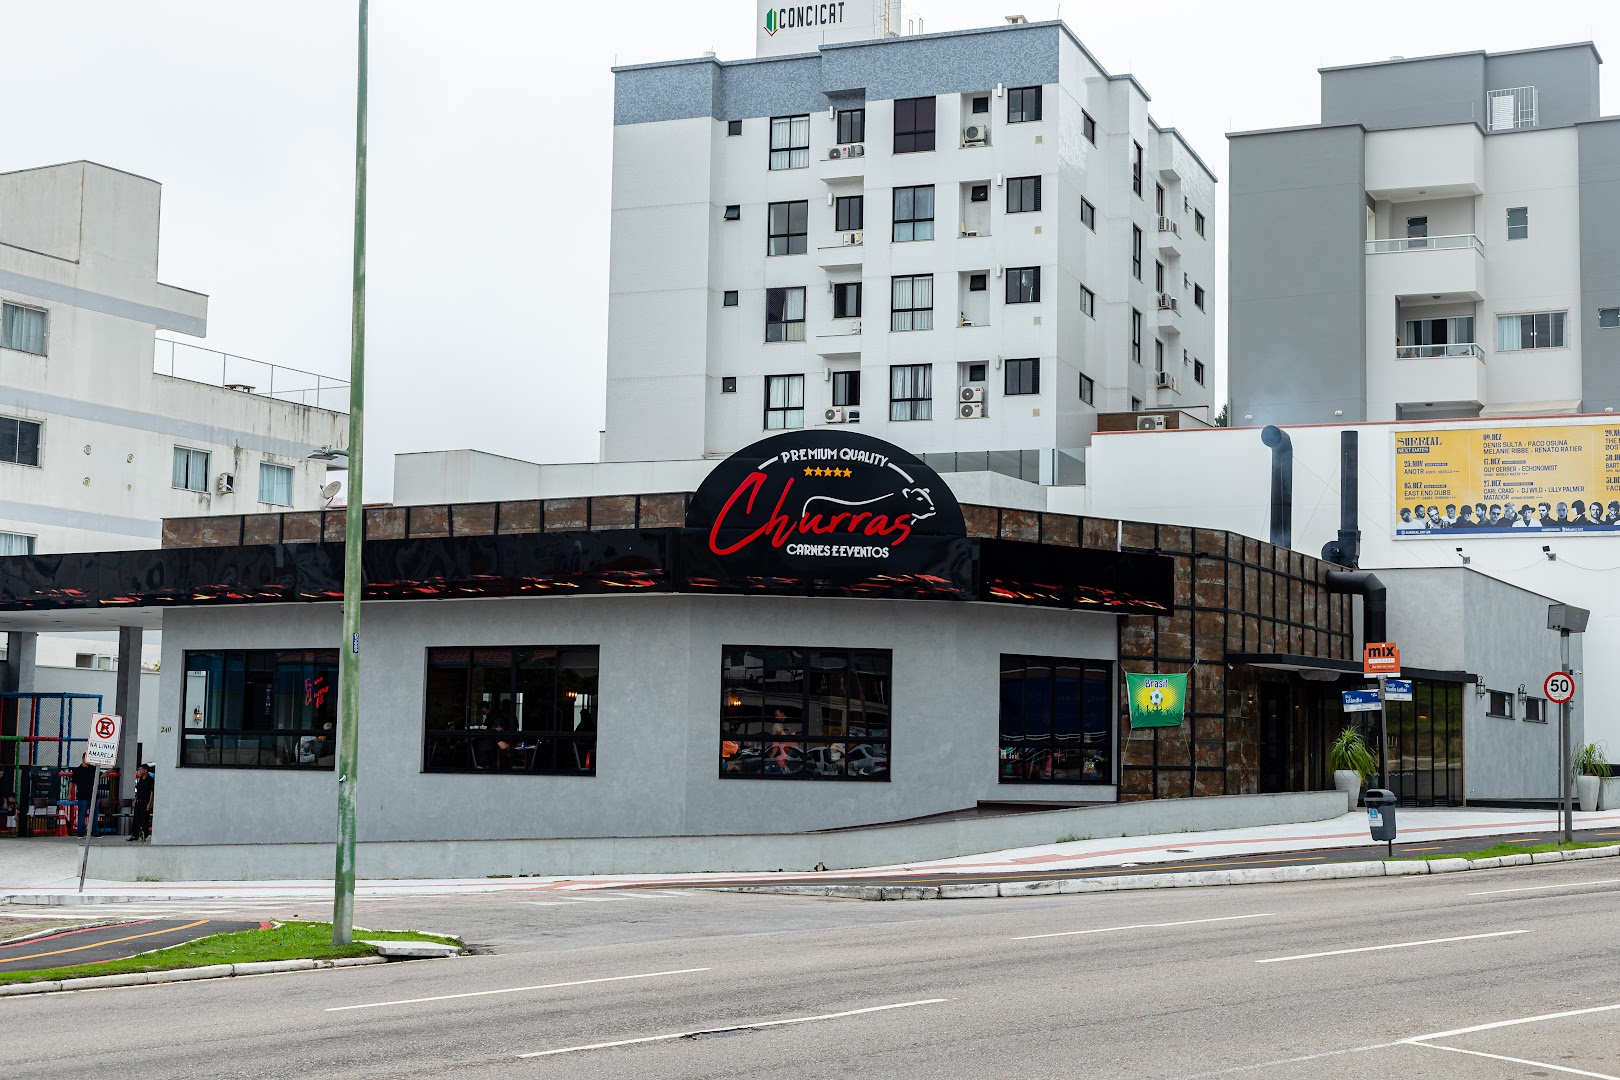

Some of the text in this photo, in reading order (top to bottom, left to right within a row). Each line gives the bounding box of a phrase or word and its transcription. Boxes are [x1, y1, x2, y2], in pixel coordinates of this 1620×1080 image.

[779, 2, 844, 29] CONCICAT
[1397, 437, 1442, 446] SURREAL
[780, 447, 889, 467] PREMIUM QUALITY
[709, 471, 911, 556] Churras
[786, 544, 831, 556] CARNES
[839, 546, 889, 558] EVENTOS
[1368, 643, 1395, 657] mix
[1145, 678, 1168, 688] Brasil
[1550, 679, 1569, 692] 50
[160, 726, 172, 734] 240
[88, 750, 114, 758] AMARELA
